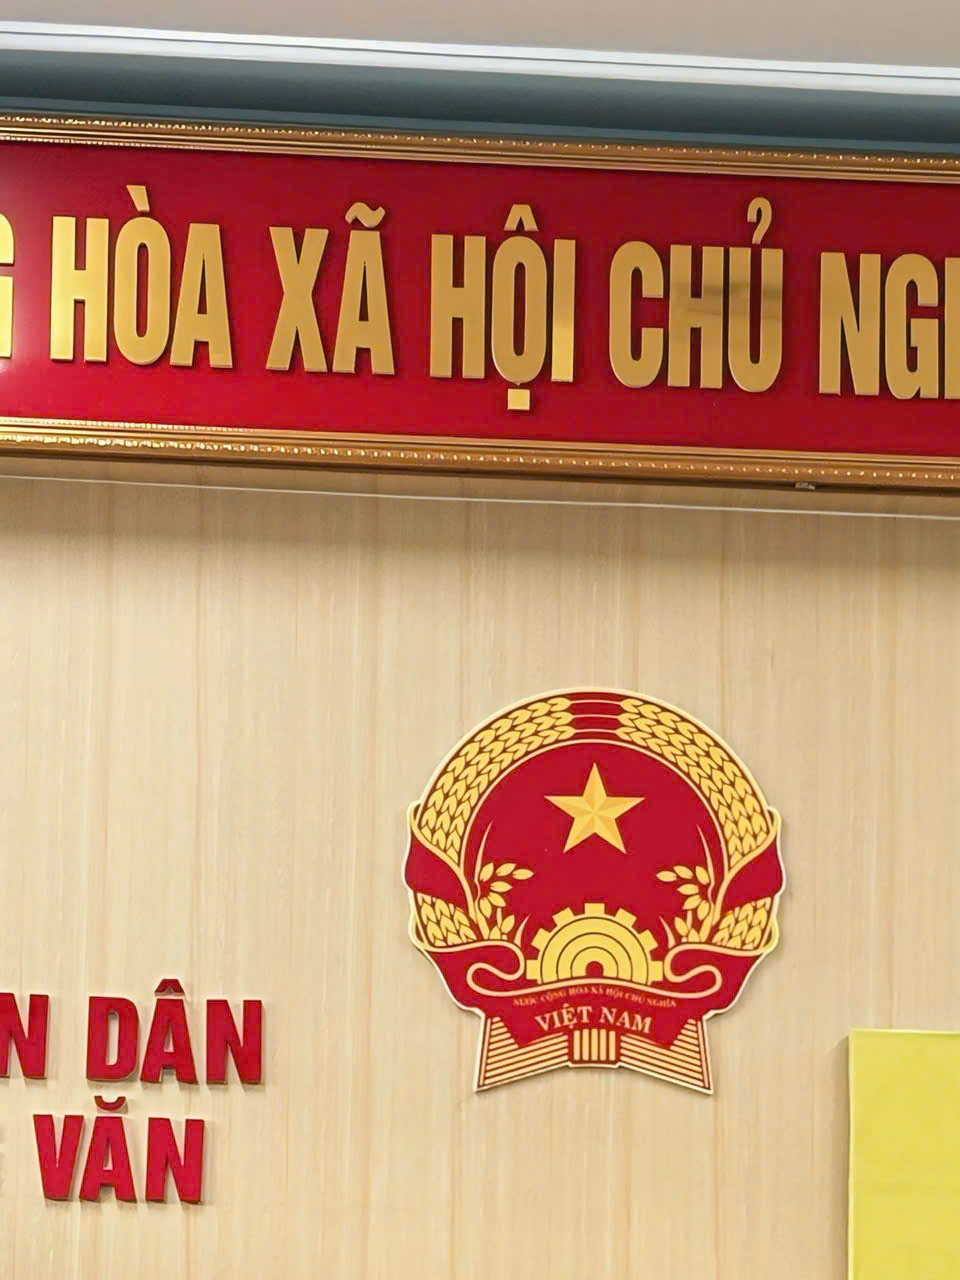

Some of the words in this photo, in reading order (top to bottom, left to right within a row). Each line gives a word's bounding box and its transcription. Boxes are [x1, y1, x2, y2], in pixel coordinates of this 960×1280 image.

[50, 184, 233, 368] HÒA
[265, 201, 395, 375] XÃ
[429, 203, 576, 411] HỘI
[608, 196, 784, 393] CHỦ
[86, 978, 263, 1085] DÂN
[534, 1002, 592, 1031] VIỆT
[599, 1006, 653, 1034] NAM
[33, 1095, 205, 1205] VĂN
